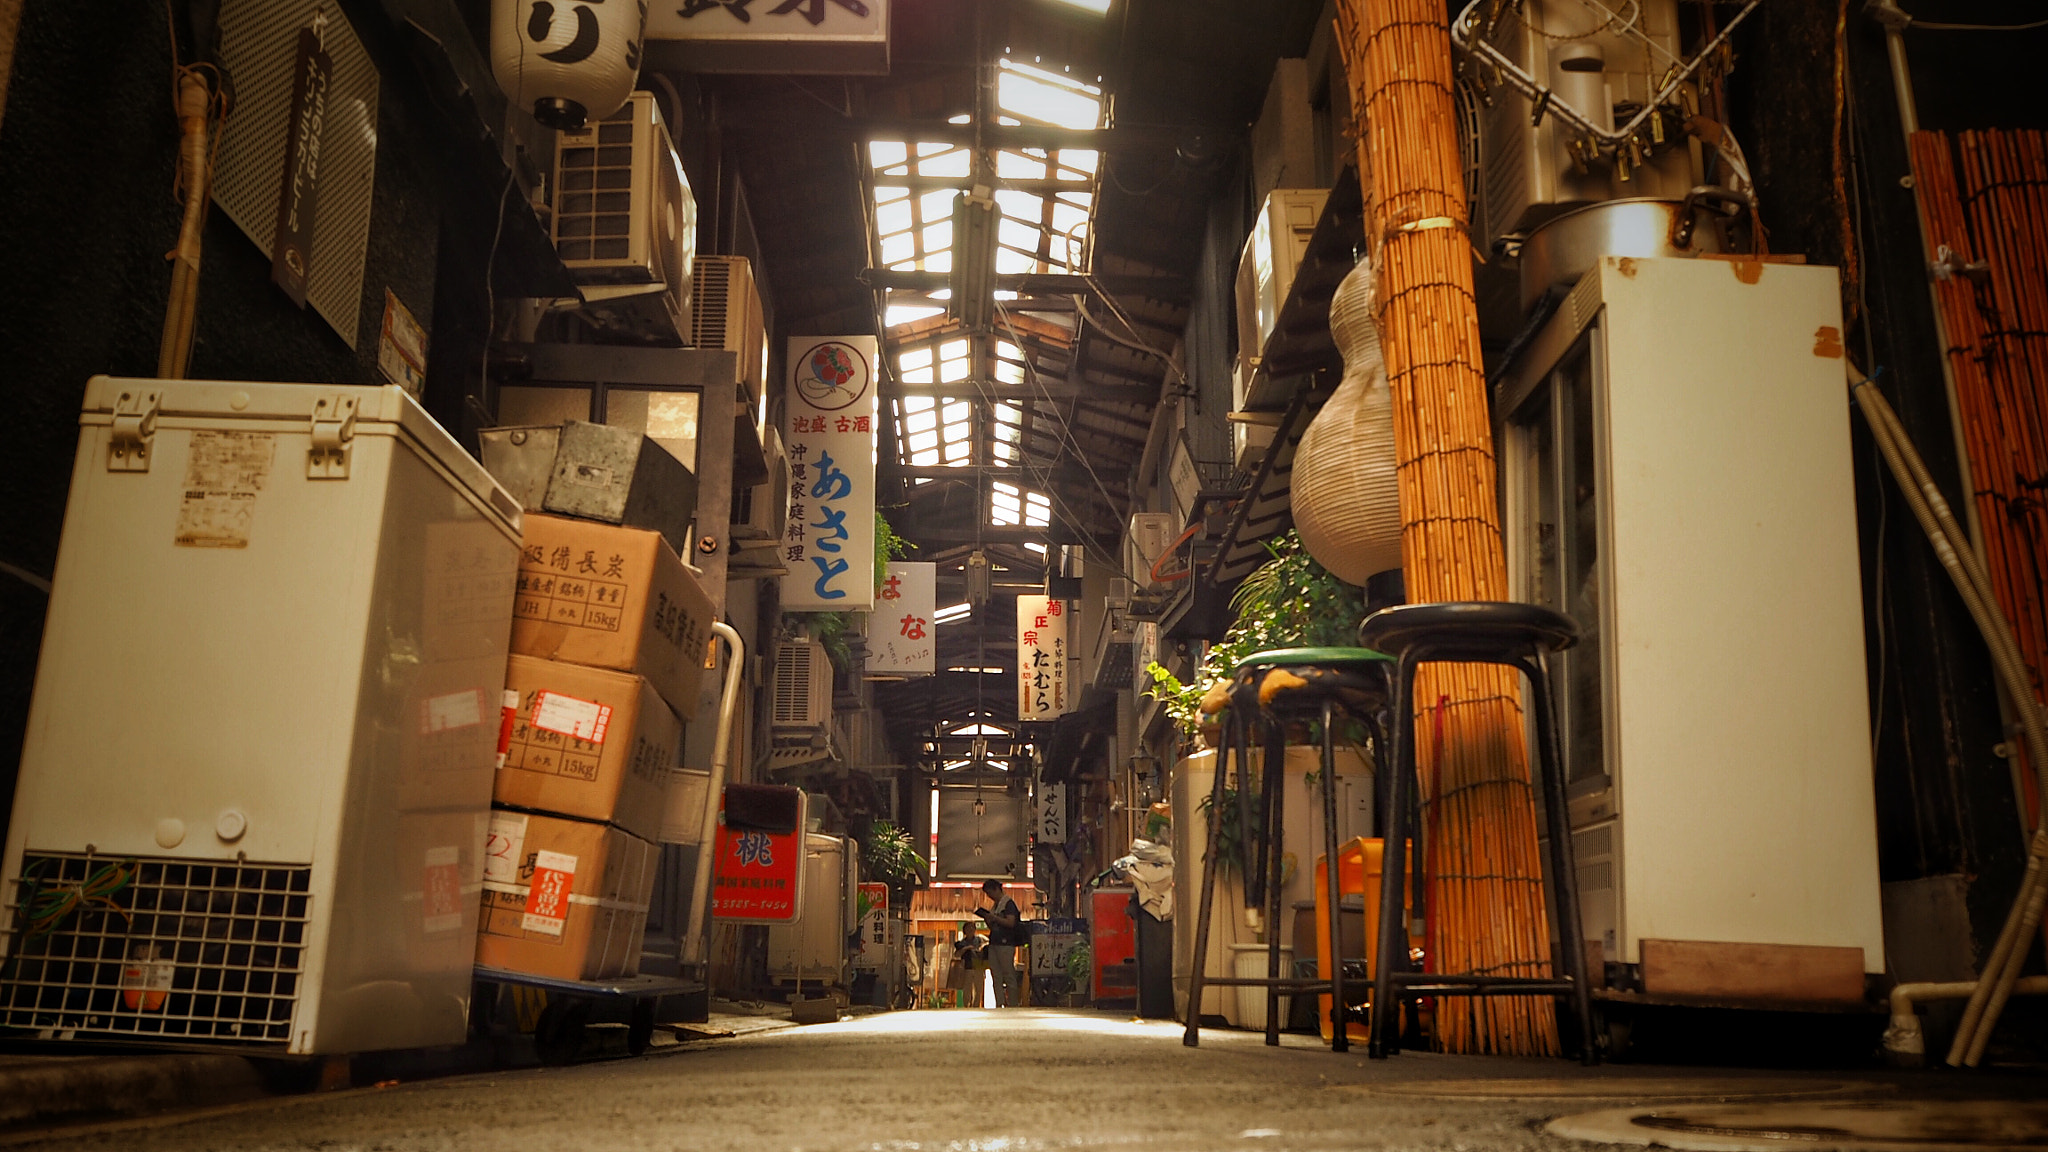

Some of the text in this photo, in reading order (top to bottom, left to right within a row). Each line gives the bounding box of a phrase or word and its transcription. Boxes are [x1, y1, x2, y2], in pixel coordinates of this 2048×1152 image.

[527, 0, 604, 64] り
[792, 415, 870, 434] 泡盛 古酒
[810, 449, 852, 600] あさと
[521, 600, 539, 615] JH
[587, 609, 618, 631] 15kg
[1023, 600, 1062, 647] 菊正宗
[1032, 648, 1051, 712] たむら
[563, 758, 595, 781] 15kg
[1043, 782, 1060, 836] せんべい
[735, 831, 774, 868] 桃
